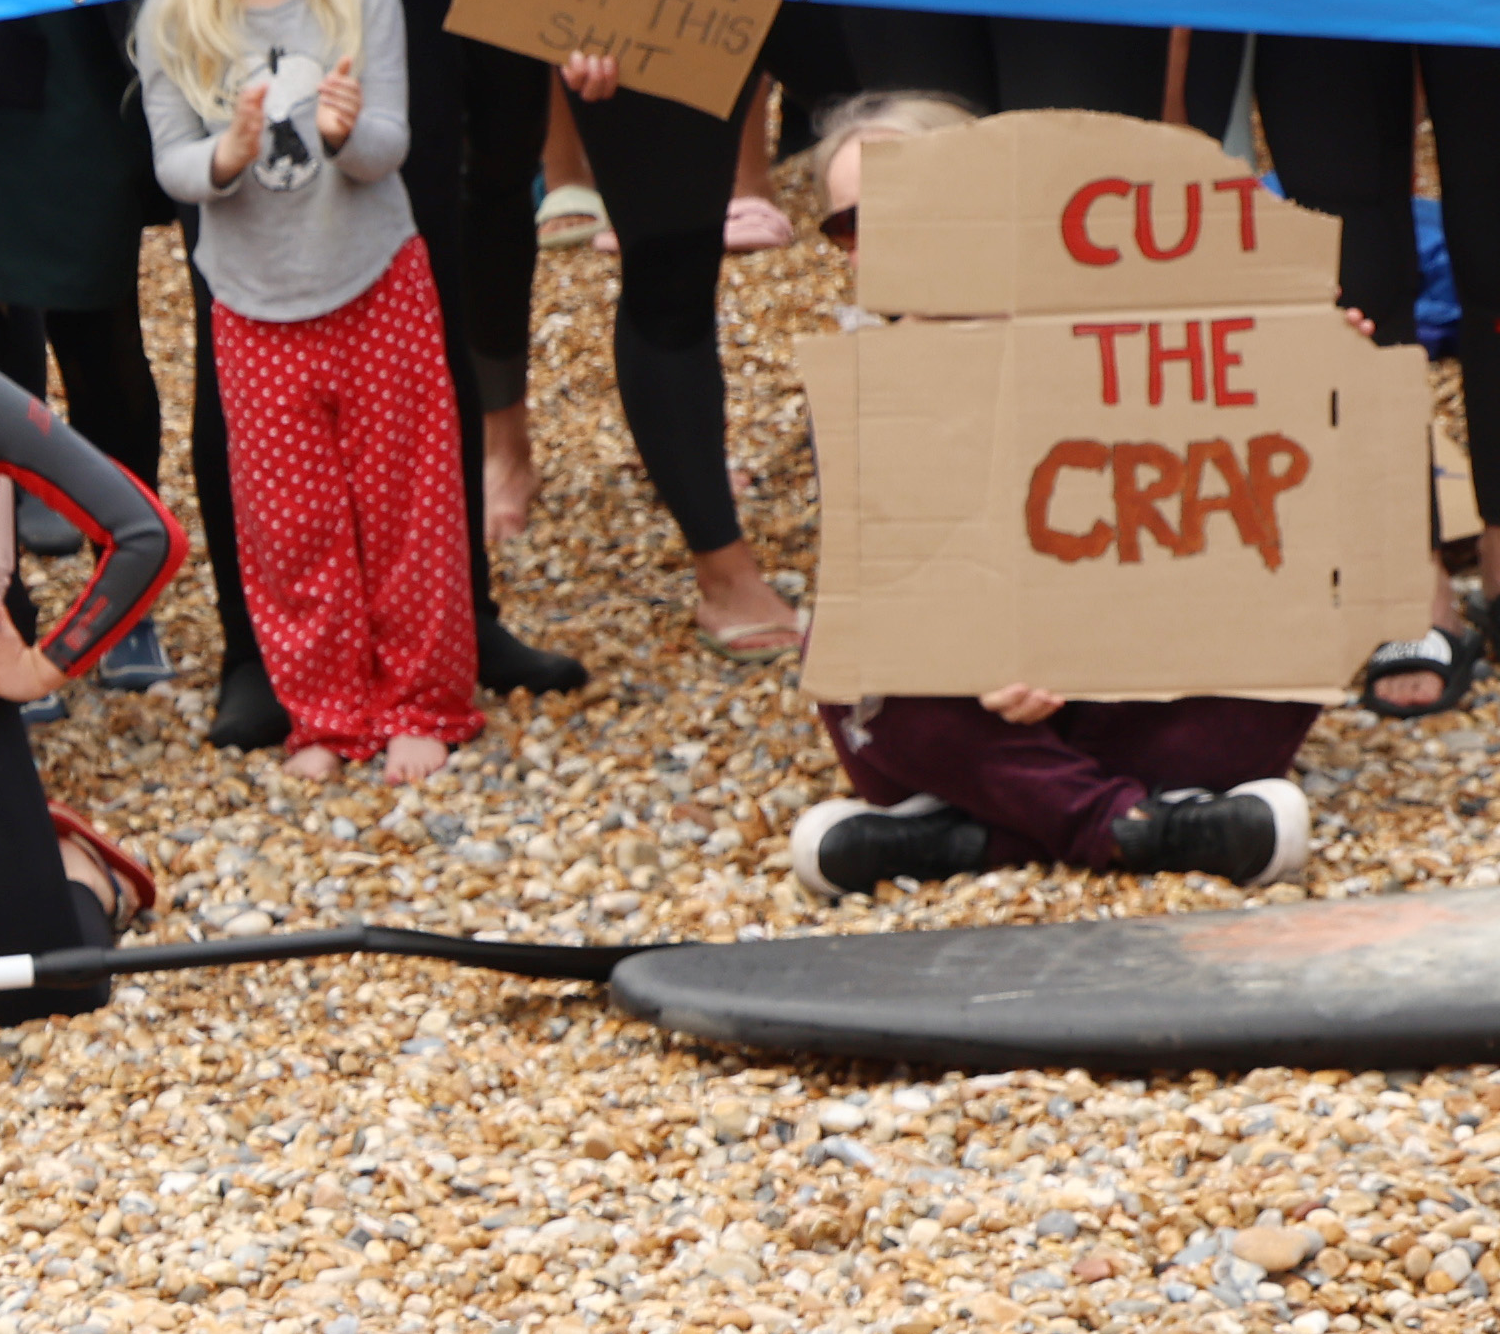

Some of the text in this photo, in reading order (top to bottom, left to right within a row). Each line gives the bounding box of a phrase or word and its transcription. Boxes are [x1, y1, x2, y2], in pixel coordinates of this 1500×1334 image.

[537, 12, 672, 74] SHIT
[1061, 176, 1266, 266] CUT
[1072, 318, 1257, 407] THE
[1025, 432, 1311, 573] CRAP
